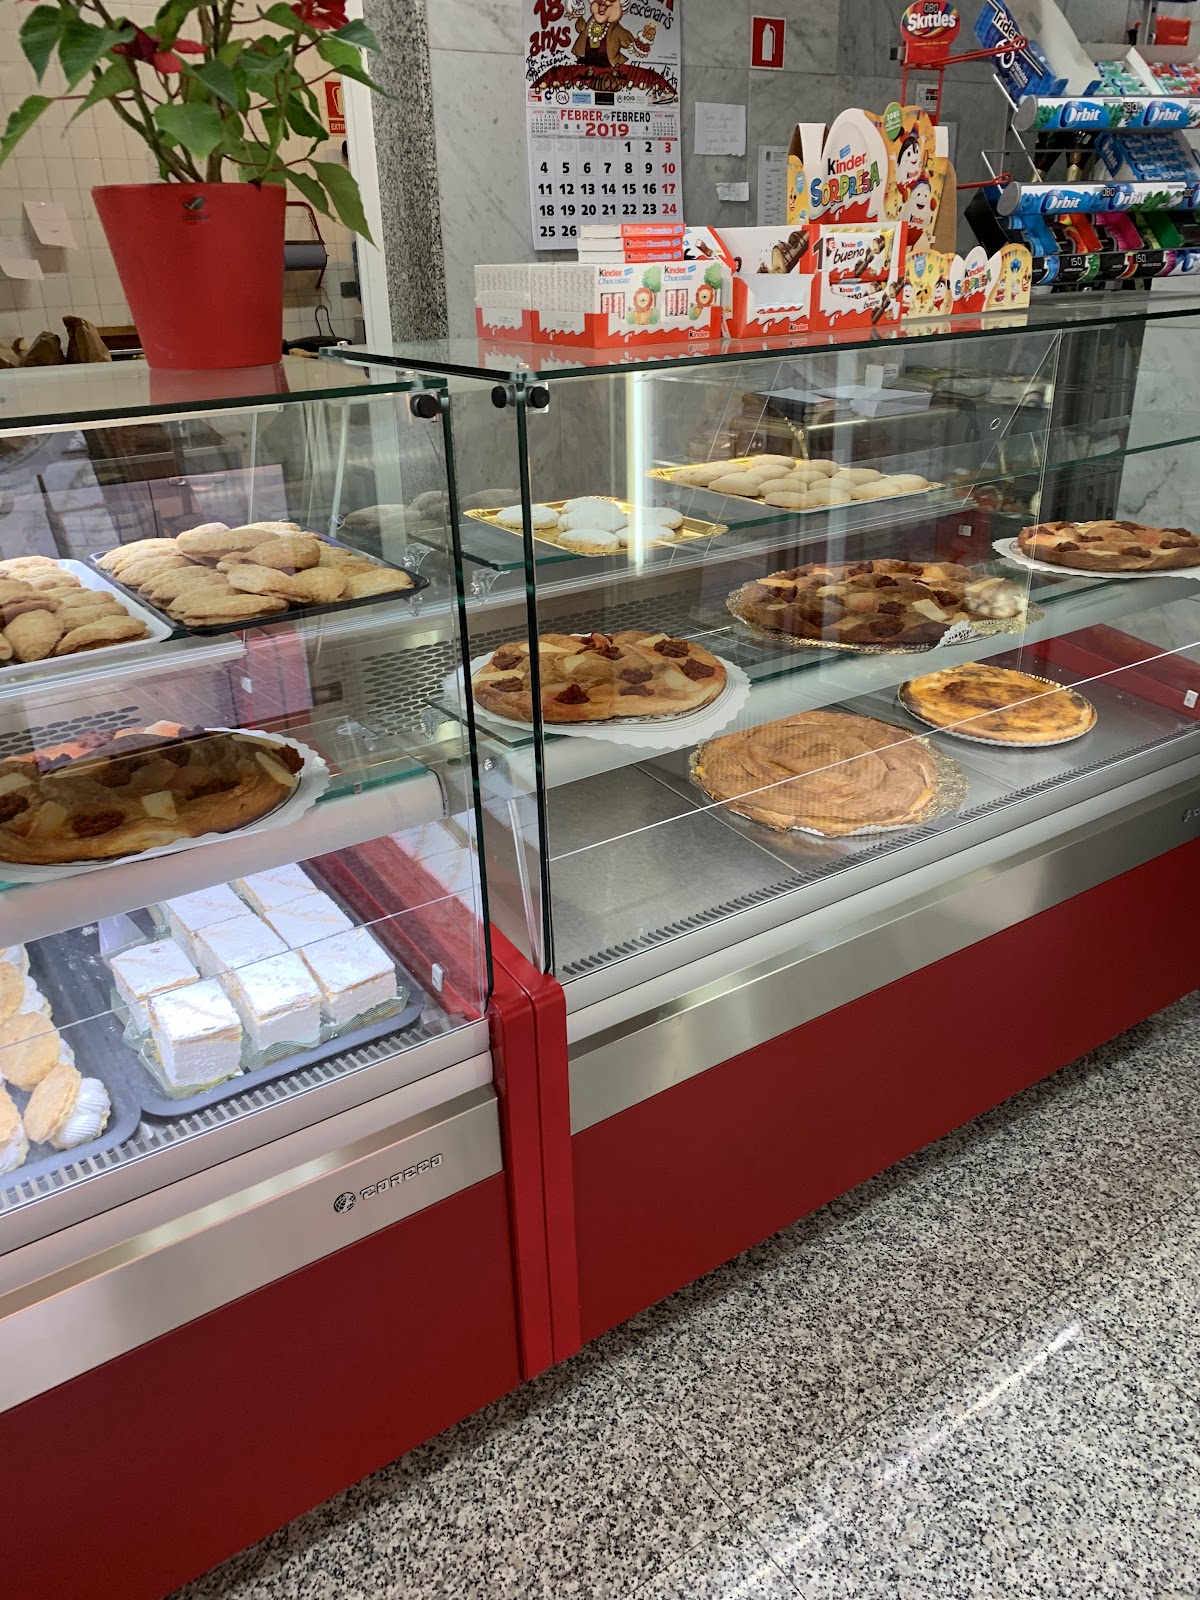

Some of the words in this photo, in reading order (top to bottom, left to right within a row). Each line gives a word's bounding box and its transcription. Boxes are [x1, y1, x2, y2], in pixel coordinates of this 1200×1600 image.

[534, 0, 565, 30] 18
[630, 3, 674, 30] escenaris
[907, 10, 956, 32] Skittles
[530, 26, 572, 56] anys
[560, 110, 602, 122] FEBRER
[611, 111, 651, 123] FEBRERO
[1063, 105, 1101, 125] Orbit
[1146, 105, 1182, 124] Orbit
[585, 123, 629, 137] 2019
[624, 141, 632, 152] 1
[645, 141, 652, 152] 2
[664, 142, 671, 153] 3
[540, 162, 548, 173] 4
[562, 162, 570, 173] 5
[583, 162, 591, 173] 6
[604, 162, 612, 173] 7
[625, 162, 633, 173] 8
[645, 162, 653, 173] 9
[662, 163, 675, 174] 10
[538, 183, 553, 195] 11
[559, 183, 574, 195] 12
[580, 183, 595, 195] 13
[601, 183, 616, 195] 14
[622, 183, 637, 195] 15
[642, 183, 657, 194] 16
[662, 183, 676, 194] 17
[811, 161, 881, 207] SORPRESA
[1043, 193, 1081, 210] Orbit
[1112, 190, 1147, 208] Orbit
[539, 205, 554, 216] 18
[560, 205, 576, 216] 19
[581, 204, 597, 216] 20
[602, 204, 616, 215] 21
[622, 204, 637, 215] 22
[642, 204, 657, 215] 23
[662, 204, 677, 214] 24
[540, 226, 556, 237] 25
[561, 225, 577, 237] 26
[833, 248, 865, 264] bueno
[597, 277, 631, 286] Chocolate
[663, 274, 694, 282] Chocolate
